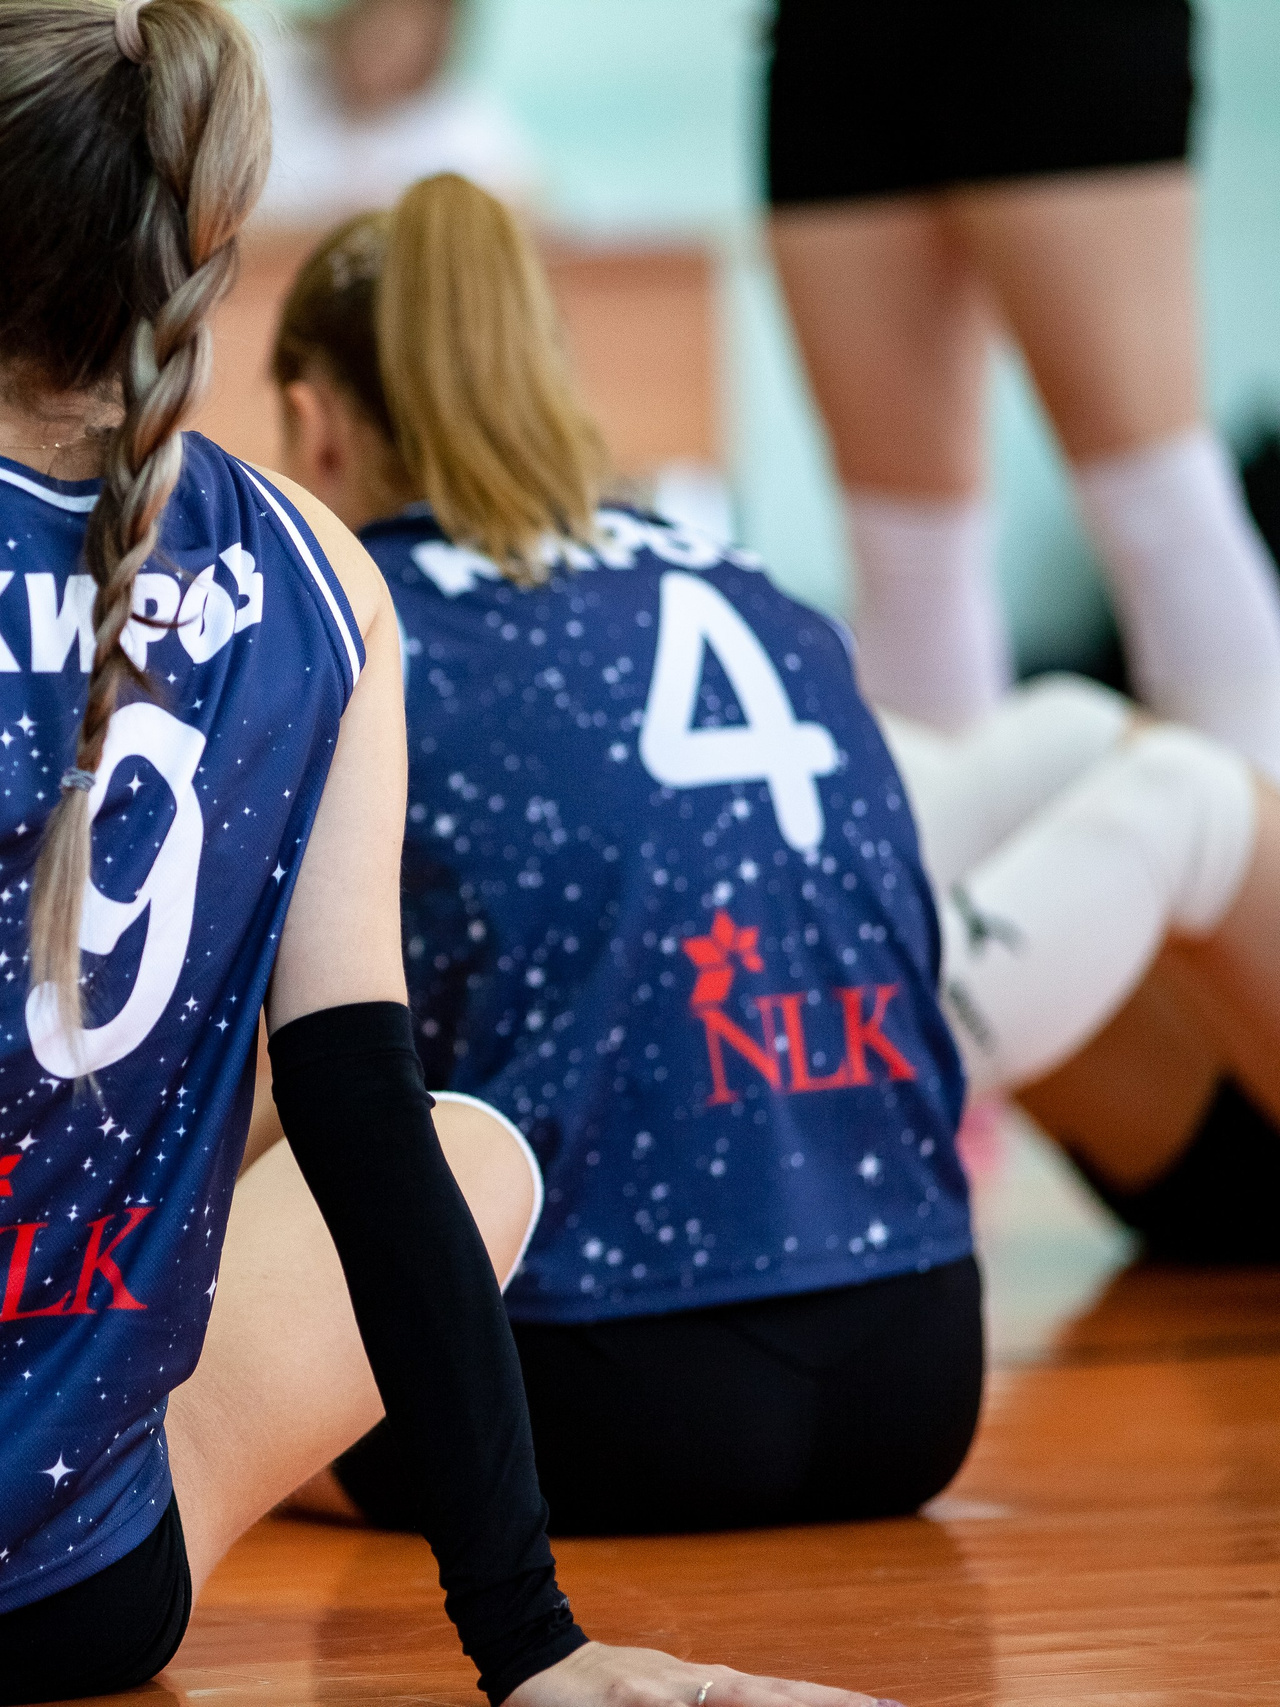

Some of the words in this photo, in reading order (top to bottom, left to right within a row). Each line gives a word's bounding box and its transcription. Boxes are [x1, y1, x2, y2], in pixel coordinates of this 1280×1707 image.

[639, 571, 841, 852] 4
[26, 702, 206, 1079] 9
[690, 983, 917, 1106] NLK
